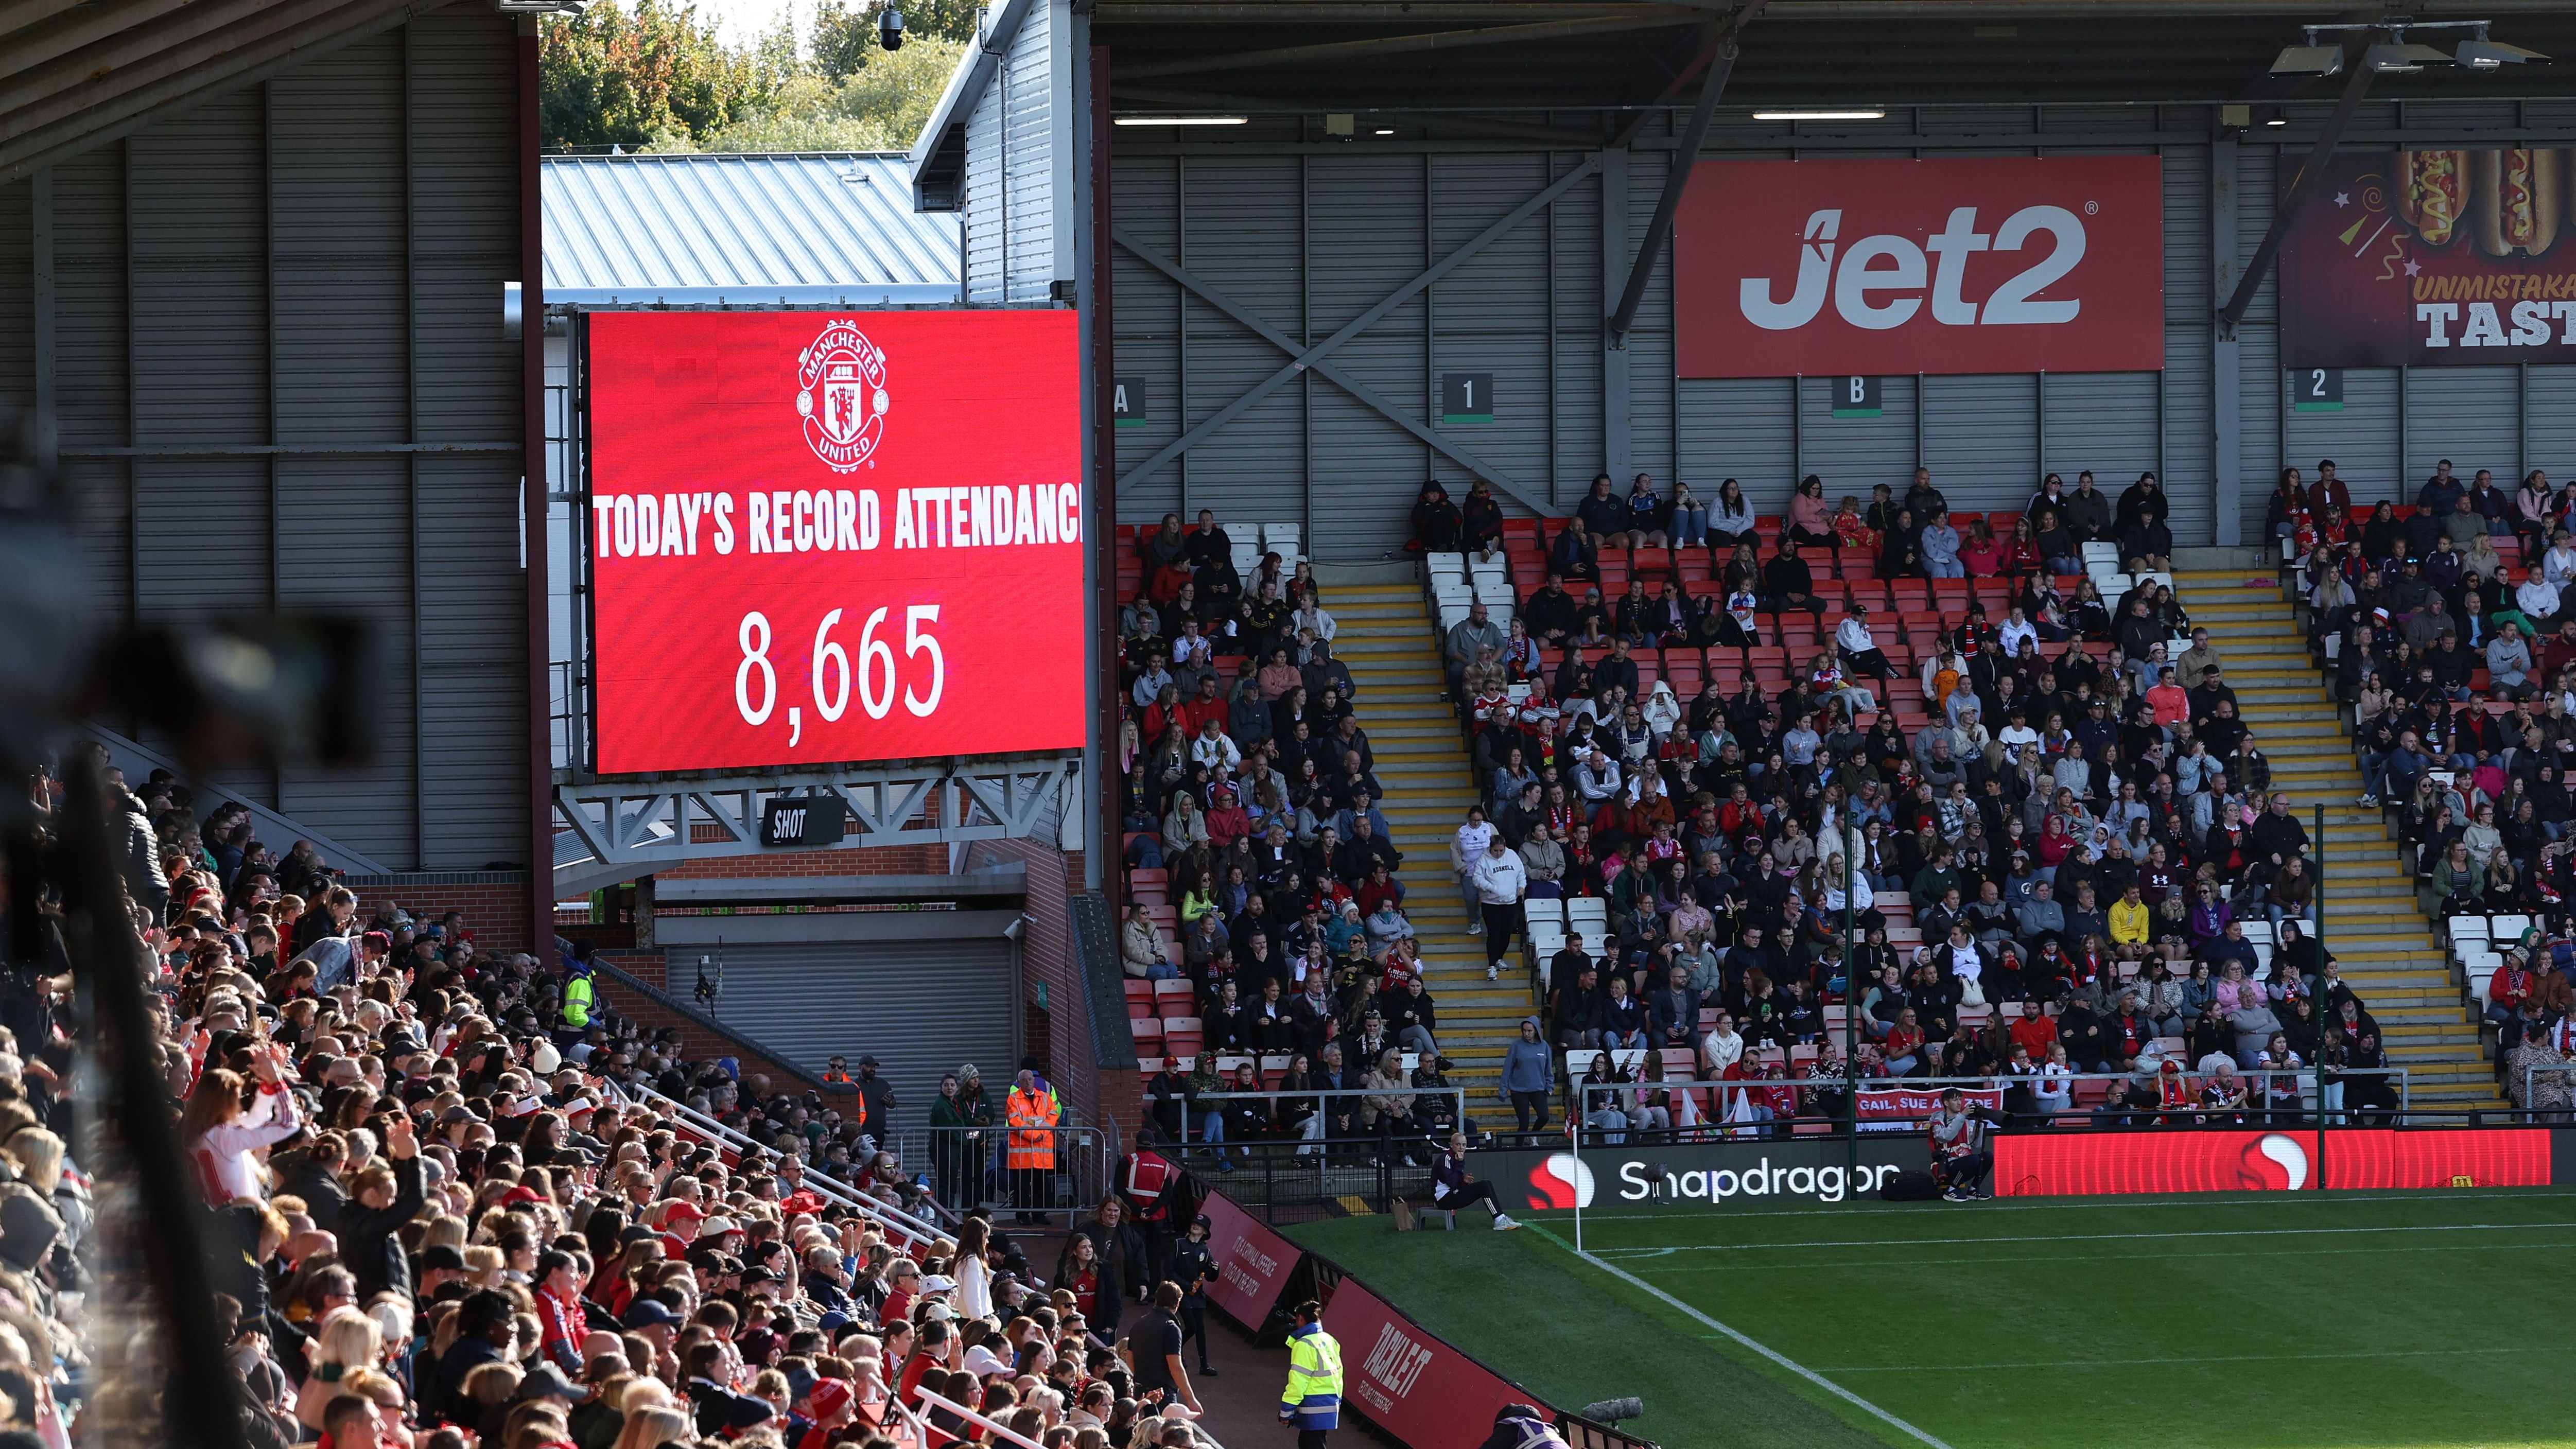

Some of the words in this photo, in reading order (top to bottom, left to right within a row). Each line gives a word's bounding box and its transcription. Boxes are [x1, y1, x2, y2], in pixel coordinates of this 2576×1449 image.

[1740, 205, 2086, 330] Jet2
[805, 332, 879, 379] MANCHESTER
[1463, 380, 1473, 408] 1
[1849, 377, 1865, 404] B
[2312, 370, 2326, 397] 2
[1114, 385, 1128, 412] A
[819, 437, 869, 462] UNITED
[593, 492, 735, 558] TODAY'S
[749, 489, 880, 553] RECORD
[894, 483, 1083, 549] ATTENDANC
[735, 604, 944, 748] 8,665
[773, 809, 806, 839] SHOT
[1493, 865, 1515, 874] ADANOLA
[1859, 1099, 1896, 1111] GAIL,
[1900, 1097, 1927, 1109] SUE
[1620, 1157, 1900, 1203] Snapdragon
[1363, 1321, 1421, 1392] TACKLE
[1397, 1348, 1433, 1399] IT
